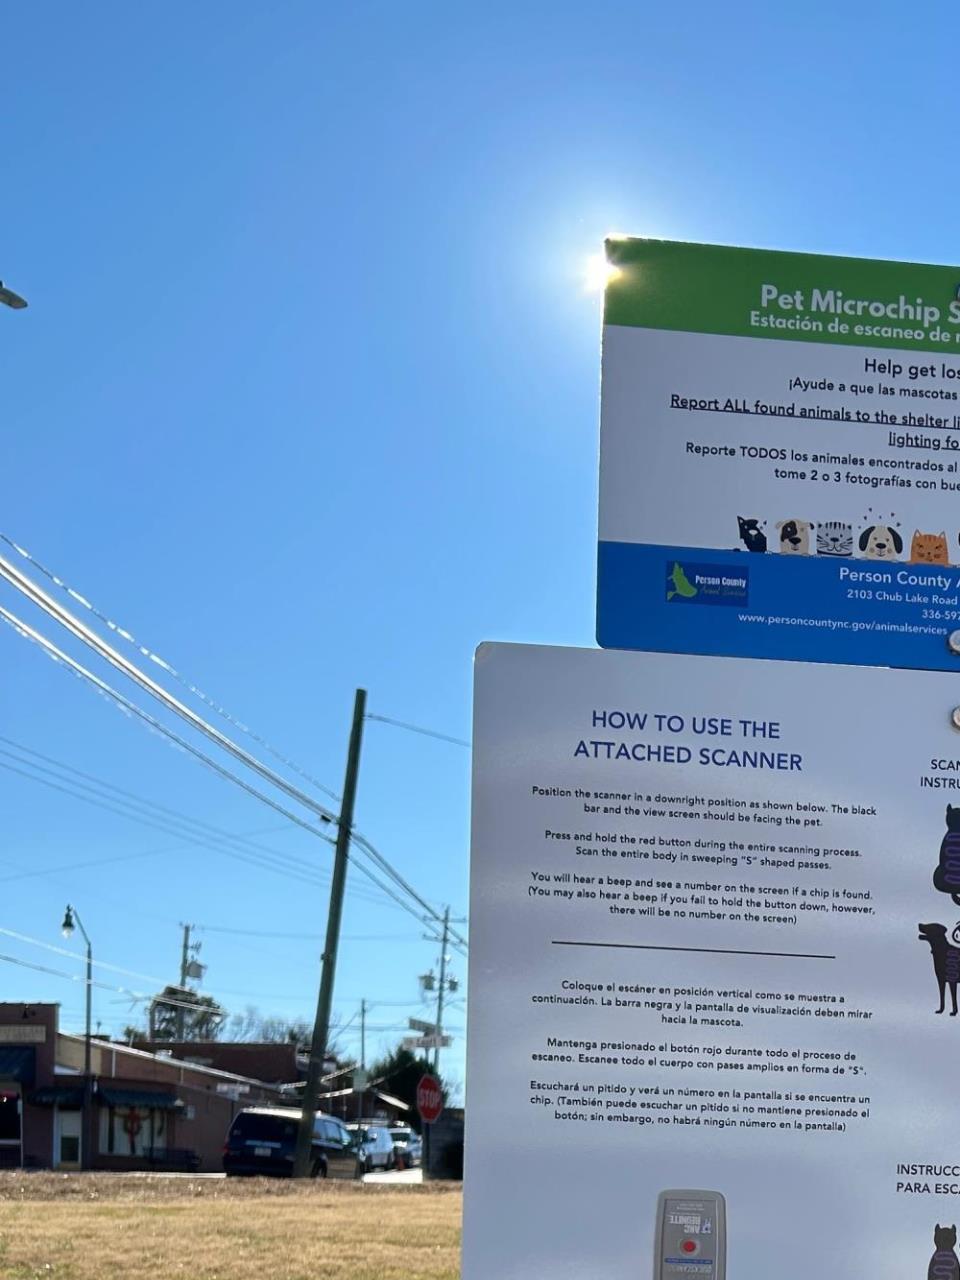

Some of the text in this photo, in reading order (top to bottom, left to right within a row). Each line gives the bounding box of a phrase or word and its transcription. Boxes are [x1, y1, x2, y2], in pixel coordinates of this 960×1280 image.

[761, 283, 804, 311] Pet
[810, 288, 940, 328] Microchip
[750, 310, 823, 332] Estación
[826, 316, 850, 334] de
[853, 324, 925, 340] escaneo
[928, 325, 951, 342] de
[864, 357, 903, 379] Help
[908, 364, 937, 380] get
[788, 376, 835, 392] ¡Ayude
[838, 383, 846, 392] a
[849, 383, 874, 396] que
[878, 382, 896, 396] las
[898, 387, 958, 401] mascotas
[670, 393, 719, 412] Report
[723, 397, 750, 414] ALL
[753, 400, 795, 417] found
[799, 403, 851, 421] animals
[855, 407, 870, 422] to
[873, 409, 897, 424] the
[901, 411, 949, 428] shelter
[887, 431, 941, 449] lighting
[685, 441, 736, 457] Reporte
[738, 445, 787, 461] TODOS
[790, 448, 809, 462] los
[811, 452, 865, 466] animales
[868, 458, 944, 472] encontrados
[946, 460, 958, 473] al
[773, 467, 807, 480] tome
[809, 468, 818, 481] 2
[821, 472, 830, 482] o
[833, 470, 841, 483] 3
[844, 471, 912, 489] fotografías
[914, 479, 937, 490] con
[694, 574, 747, 588] Person County
[839, 566, 892, 584] Person
[896, 570, 952, 591] County
[846, 588, 873, 600] 2103
[874, 590, 903, 602] Chub
[905, 592, 929, 604] Lake
[931, 594, 958, 606] Road
[738, 614, 947, 634] www.personcountync.gov/animalservices
[592, 709, 780, 739] HOW TO USE THE
[573, 739, 802, 771] ATTACHED SCANNER
[531, 785, 877, 816] Position the scanner in a downright position as shown below. The black
[660, 1013, 744, 1027] hacia la mascota.
[546, 1037, 856, 1061] Mantenga presionado el botón rojo durante todo el proceso de
[419, 1088, 441, 1109] STOP
[895, 1181, 931, 1194] PARA
